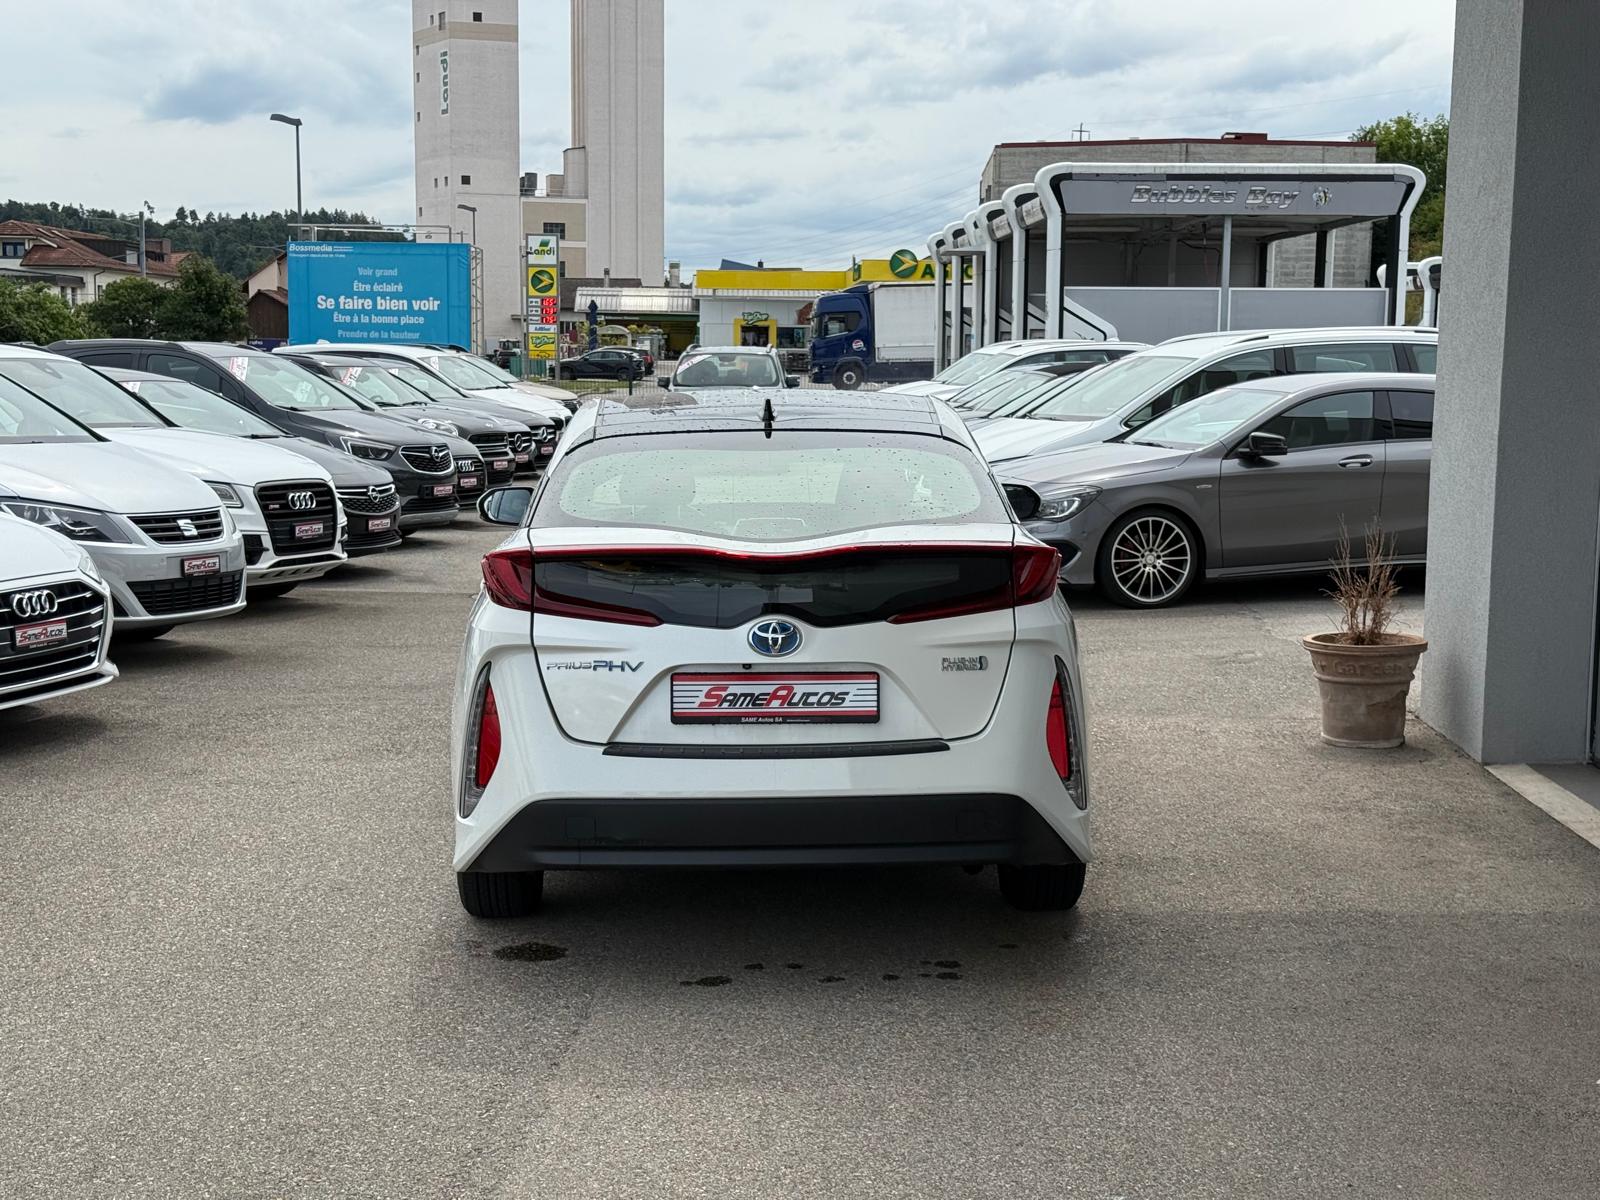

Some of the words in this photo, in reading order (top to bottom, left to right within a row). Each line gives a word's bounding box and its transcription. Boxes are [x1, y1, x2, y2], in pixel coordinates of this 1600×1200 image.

[440, 50, 449, 115] Landi
[1130, 185, 1238, 203] Bubbles
[1246, 186, 1300, 208] Bay
[289, 243, 333, 252] Bossmedia
[529, 246, 555, 256] Landi
[357, 267, 373, 276] Voir
[375, 267, 398, 278] grand
[353, 280, 371, 292] Être
[372, 281, 403, 292] éclairé
[317, 295, 335, 309] Se
[338, 296, 373, 310] faire
[377, 296, 409, 310] bien
[412, 297, 441, 311] voir
[333, 311, 351, 323] Être
[353, 313, 359, 323] à
[360, 314, 369, 323] la
[371, 314, 398, 324] bonne
[400, 315, 425, 326] place
[337, 329, 368, 339] Prendre
[369, 330, 379, 339] de
[381, 330, 389, 339] la
[390, 330, 421, 340] hauteur
